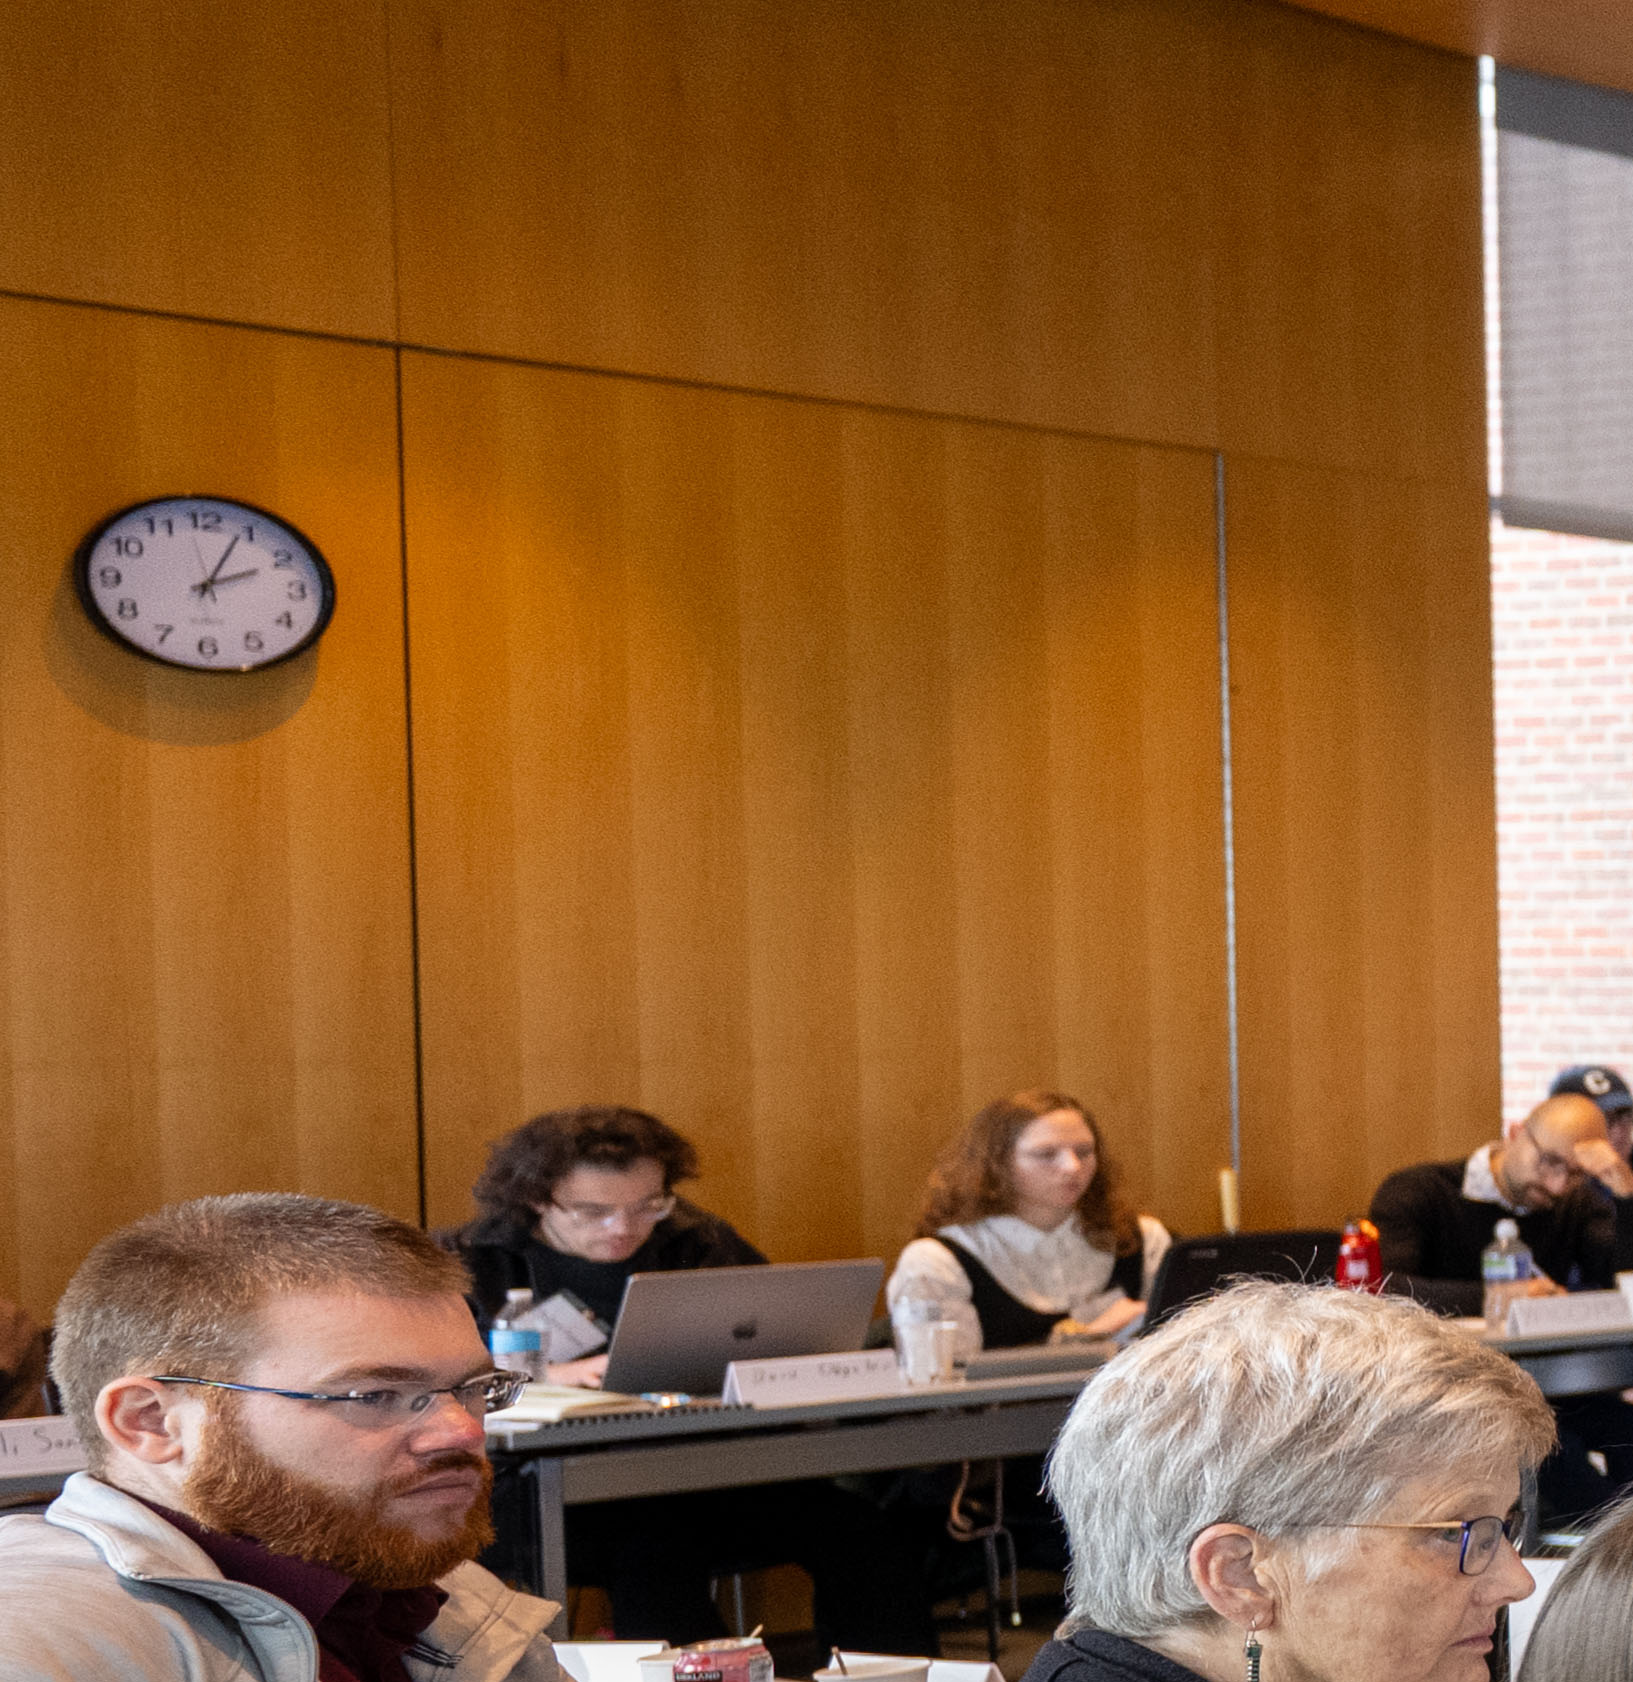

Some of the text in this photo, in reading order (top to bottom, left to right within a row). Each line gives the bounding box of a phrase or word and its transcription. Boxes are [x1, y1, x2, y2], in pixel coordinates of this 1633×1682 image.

[144, 516, 174, 536] 11
[189, 510, 222, 533] 12
[242, 524, 254, 542] 1
[110, 536, 144, 558] 10
[273, 549, 292, 568] 2
[100, 566, 121, 588] 9
[288, 579, 306, 601] 3
[118, 598, 138, 621] 8
[275, 611, 293, 629] 4
[155, 624, 175, 644] 7
[244, 630, 264, 652] 5
[198, 636, 218, 658] 6
